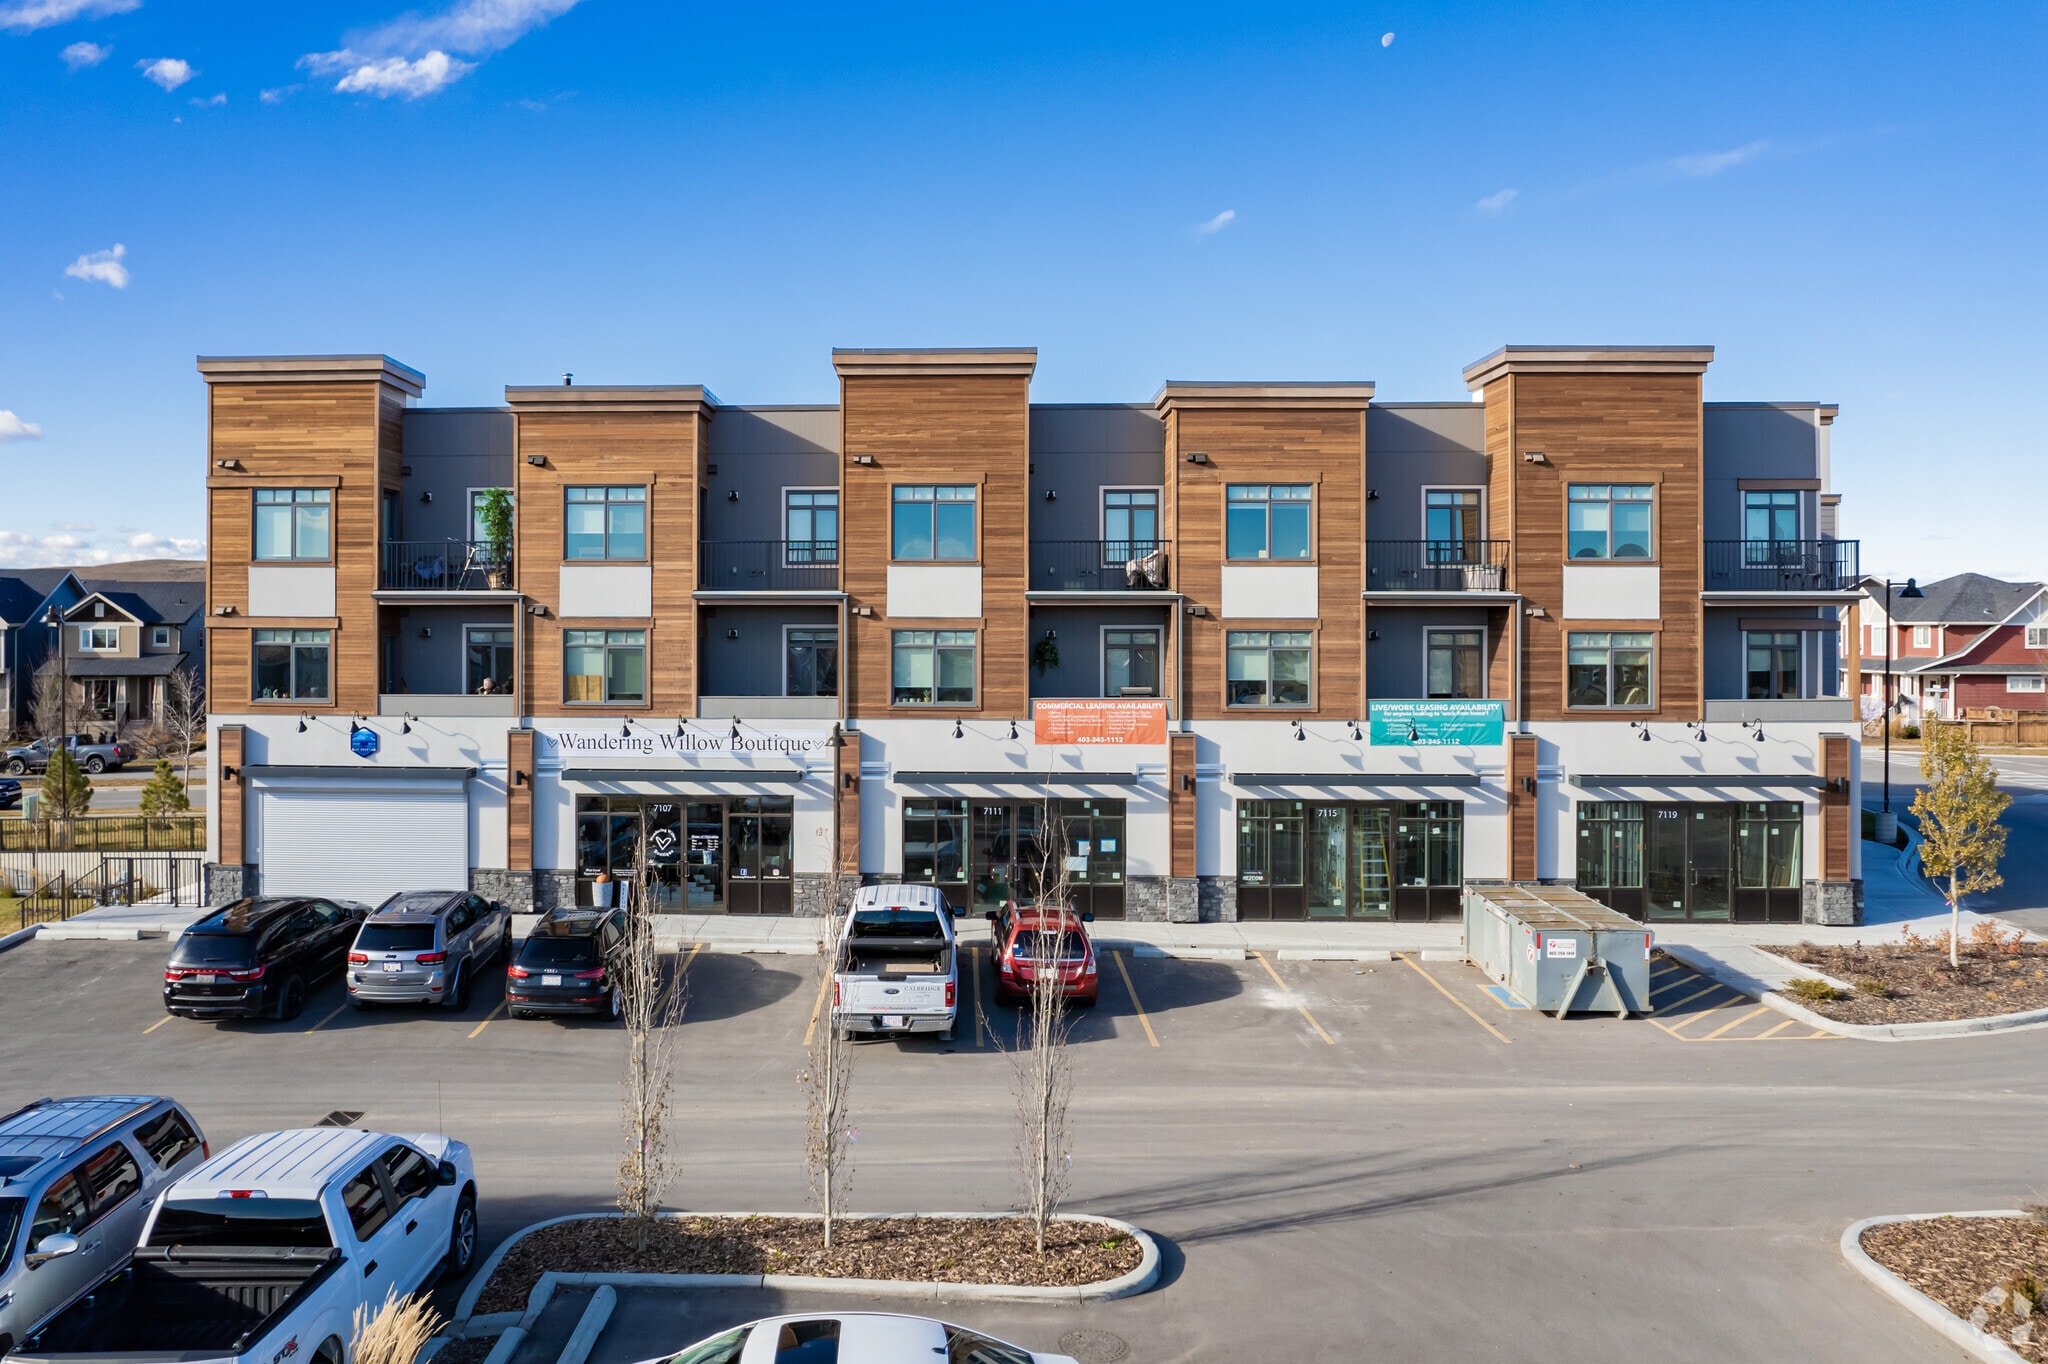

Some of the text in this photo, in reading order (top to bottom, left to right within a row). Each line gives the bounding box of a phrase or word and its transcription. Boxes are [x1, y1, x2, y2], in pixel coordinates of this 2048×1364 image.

[1036, 702, 1163, 710] COMMERCIAL LEASING AVAILABILITY
[1450, 703, 1500, 711] AVAILABILITY
[559, 733, 811, 755] Wandering Willow Boutique
[653, 804, 673, 812] 7107
[983, 807, 1002, 815] 7111
[1318, 809, 1338, 817] 7115
[1658, 810, 1678, 819] 7119
